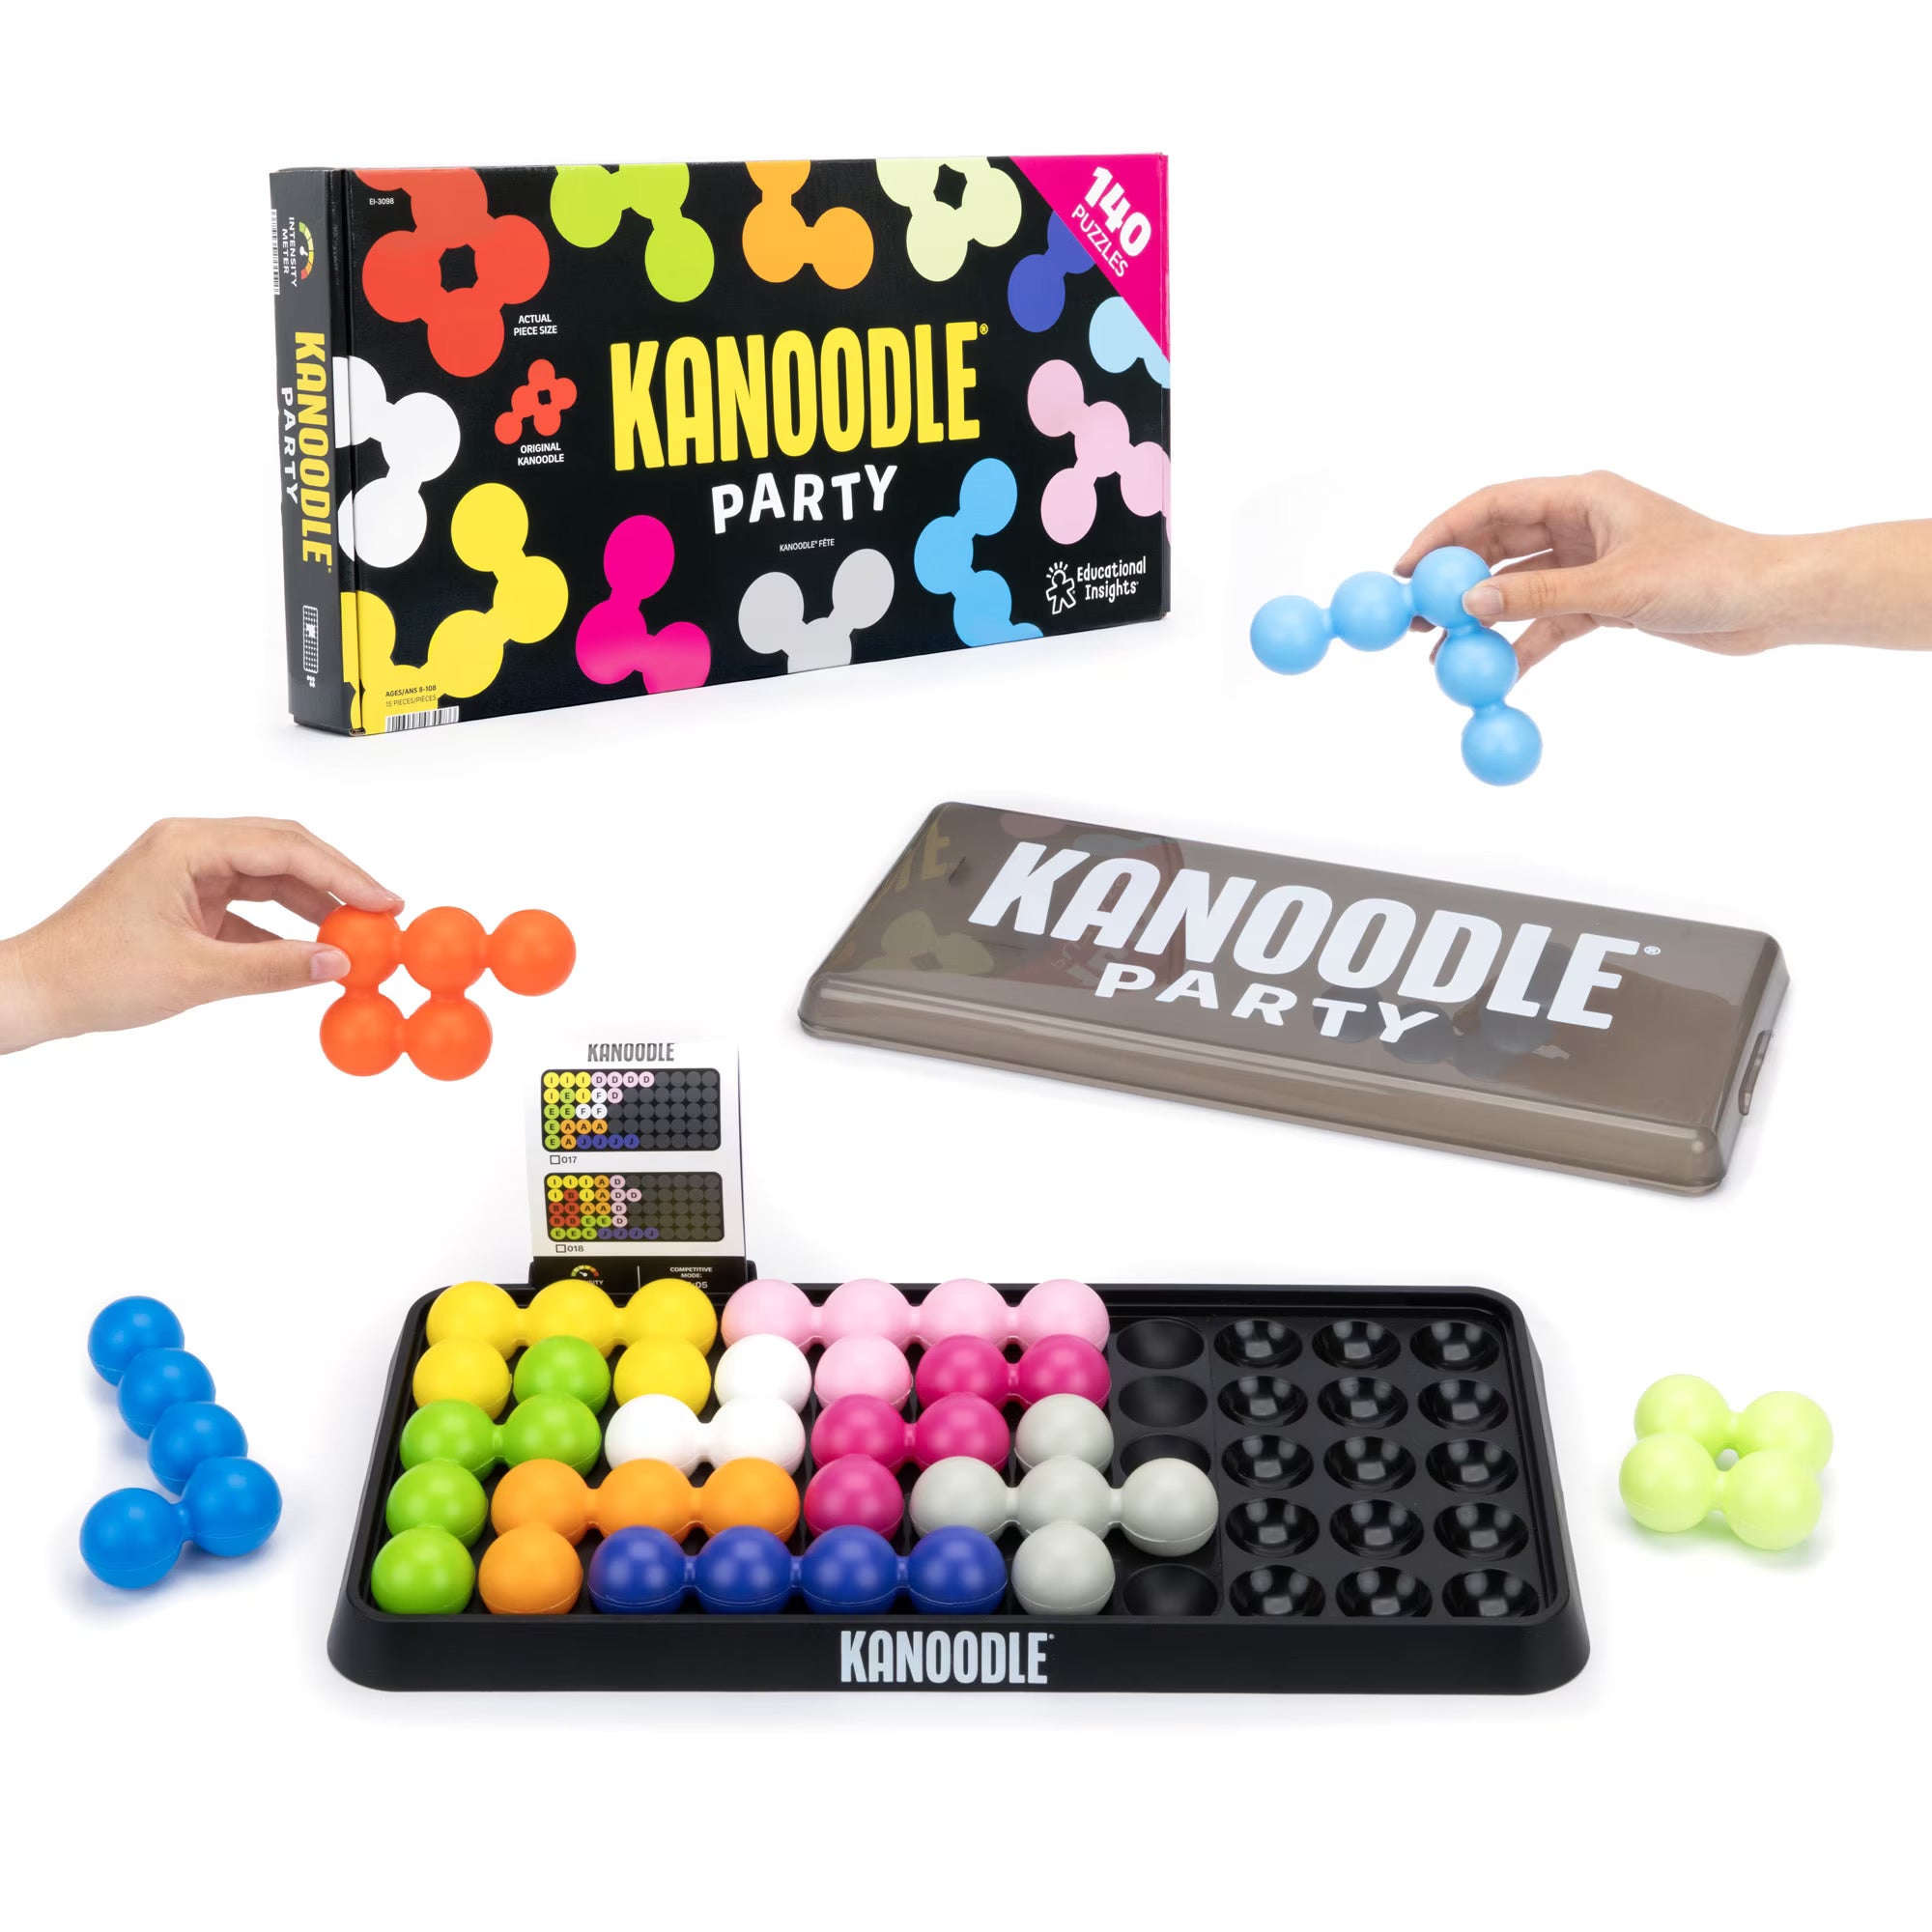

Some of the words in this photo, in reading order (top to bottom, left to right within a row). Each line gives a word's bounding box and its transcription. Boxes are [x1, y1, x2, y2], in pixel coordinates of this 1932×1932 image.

[369, 197, 395, 206] EI-3098
[1084, 166, 1151, 257] 140
[289, 216, 298, 287] INTENSITY
[1071, 204, 1128, 277] PUZZLES
[513, 327, 538, 336] PIECE
[539, 325, 558, 334] SIZE
[518, 313, 552, 325] ACTUAL
[281, 386, 298, 504] PARTY
[295, 331, 333, 567] KANOODLE
[517, 453, 565, 467] KANOODLE
[520, 441, 561, 454] ORIGINAL
[711, 464, 898, 535] PARTY
[1077, 555, 1147, 582] Educational
[385, 687, 418, 697] AGES/ANS
[1094, 962, 1439, 1044] PARTY
[587, 1042, 675, 1063] KANOODLE
[840, 1630, 1049, 1685] KANOODLE
